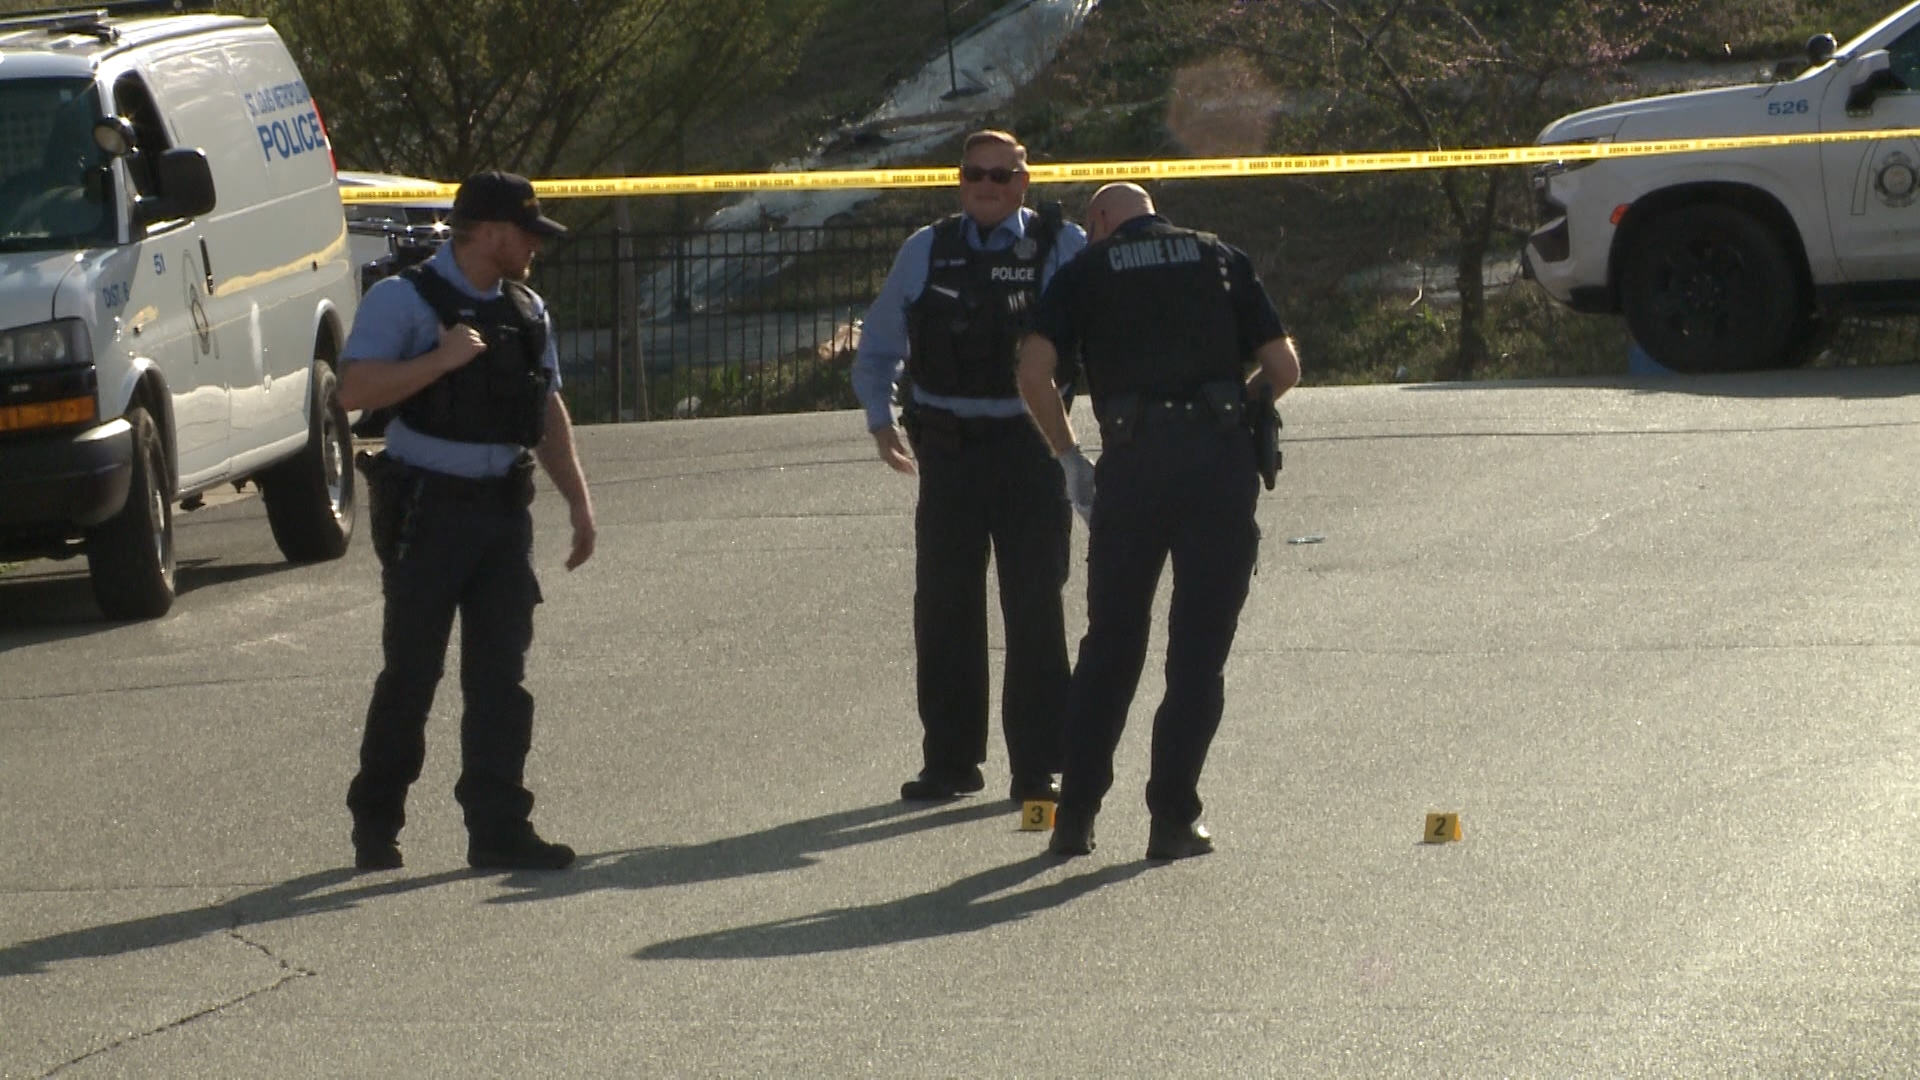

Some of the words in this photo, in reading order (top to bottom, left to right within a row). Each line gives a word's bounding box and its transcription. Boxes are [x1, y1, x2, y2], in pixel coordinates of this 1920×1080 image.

[1768, 100, 1809, 116] 526
[256, 111, 326, 162] POLICE
[153, 252, 166, 276] 51
[1108, 240, 1166, 271] CRIME
[1165, 237, 1201, 263] LAB
[991, 266, 1035, 281] POLICE
[1030, 805, 1044, 825] 3
[1433, 816, 1447, 836] 2
